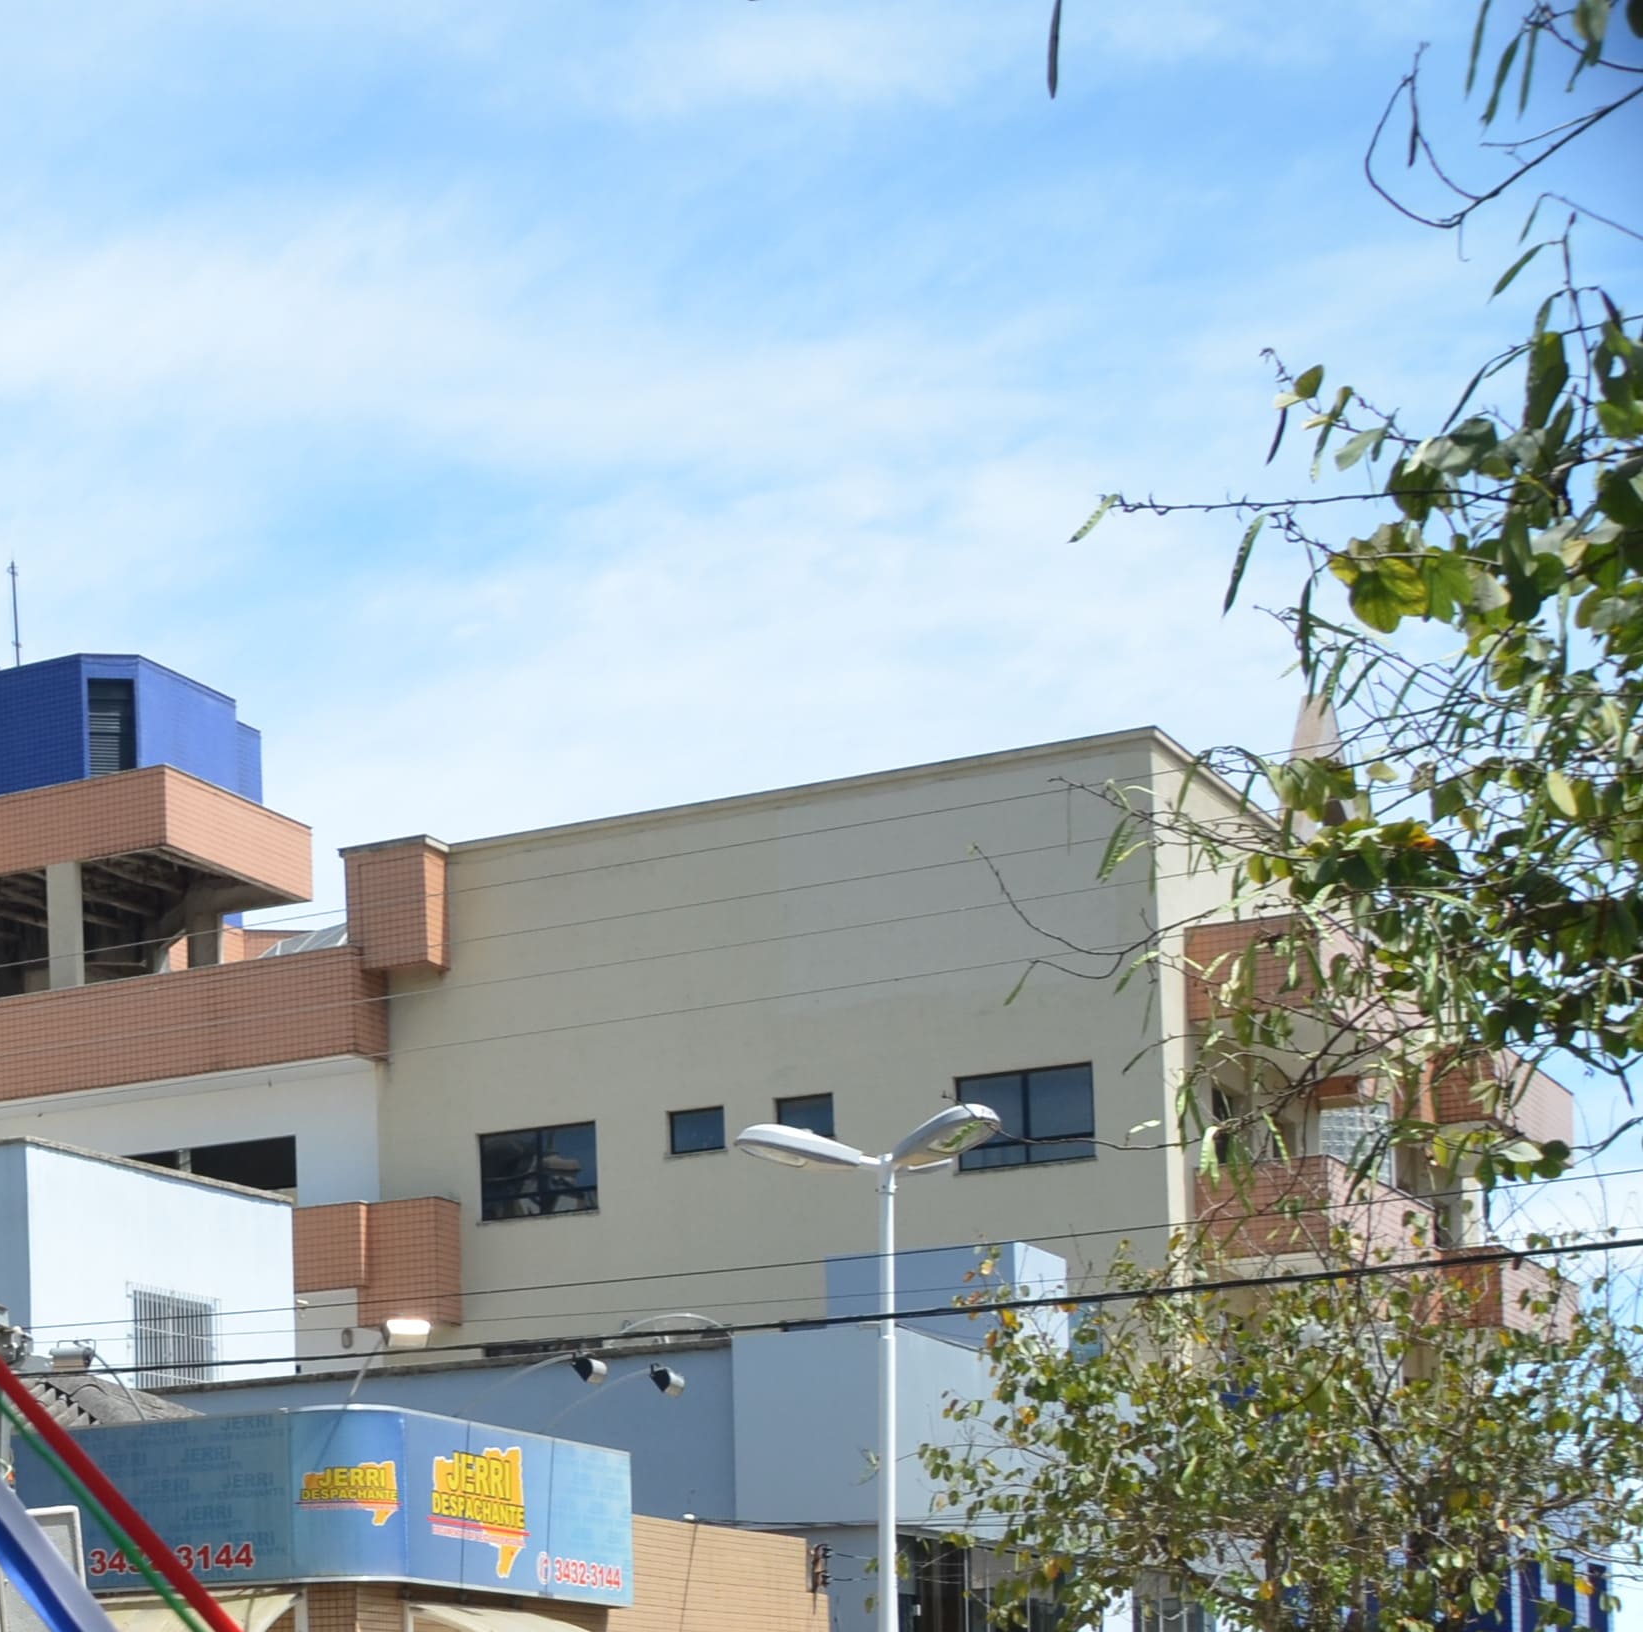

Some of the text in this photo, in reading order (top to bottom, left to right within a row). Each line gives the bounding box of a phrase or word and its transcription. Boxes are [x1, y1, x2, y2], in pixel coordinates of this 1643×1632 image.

[318, 1466, 386, 1488] JERRI
[446, 1450, 512, 1501] JERRI
[300, 1488, 399, 1501] DESPACHANTE
[431, 1491, 526, 1530] DESPACHANTE
[554, 1557, 623, 1591] 3432-3144
